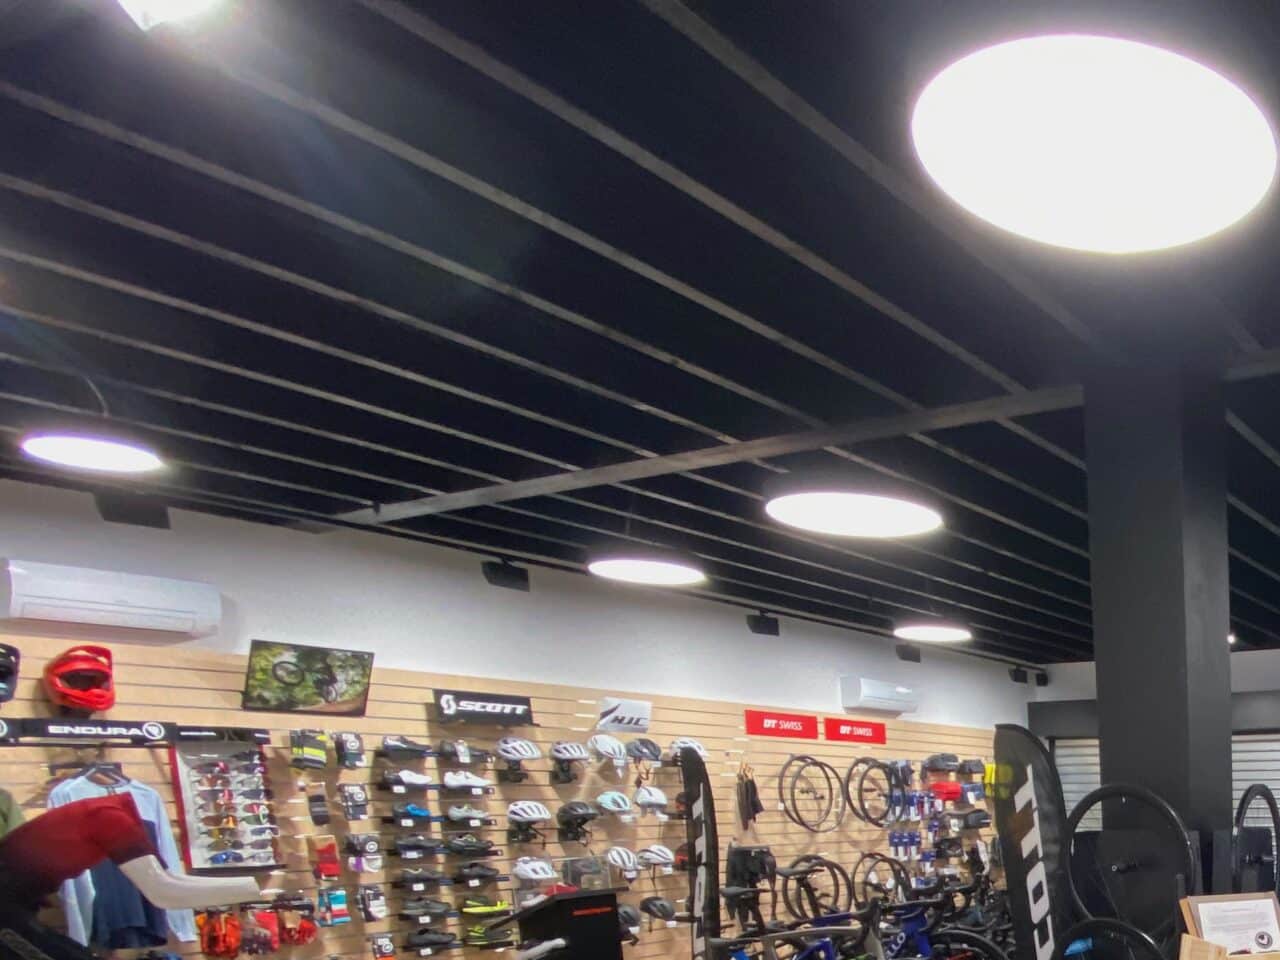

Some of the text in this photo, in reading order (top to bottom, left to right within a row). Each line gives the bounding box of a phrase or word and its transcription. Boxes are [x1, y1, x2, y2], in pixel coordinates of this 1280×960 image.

[456, 700, 528, 715] SCOTT
[610, 715, 648, 727] HJC
[763, 718, 803, 731] DT SWISS
[47, 724, 144, 736] ENDURA
[839, 725, 873, 737] DT SWISS
